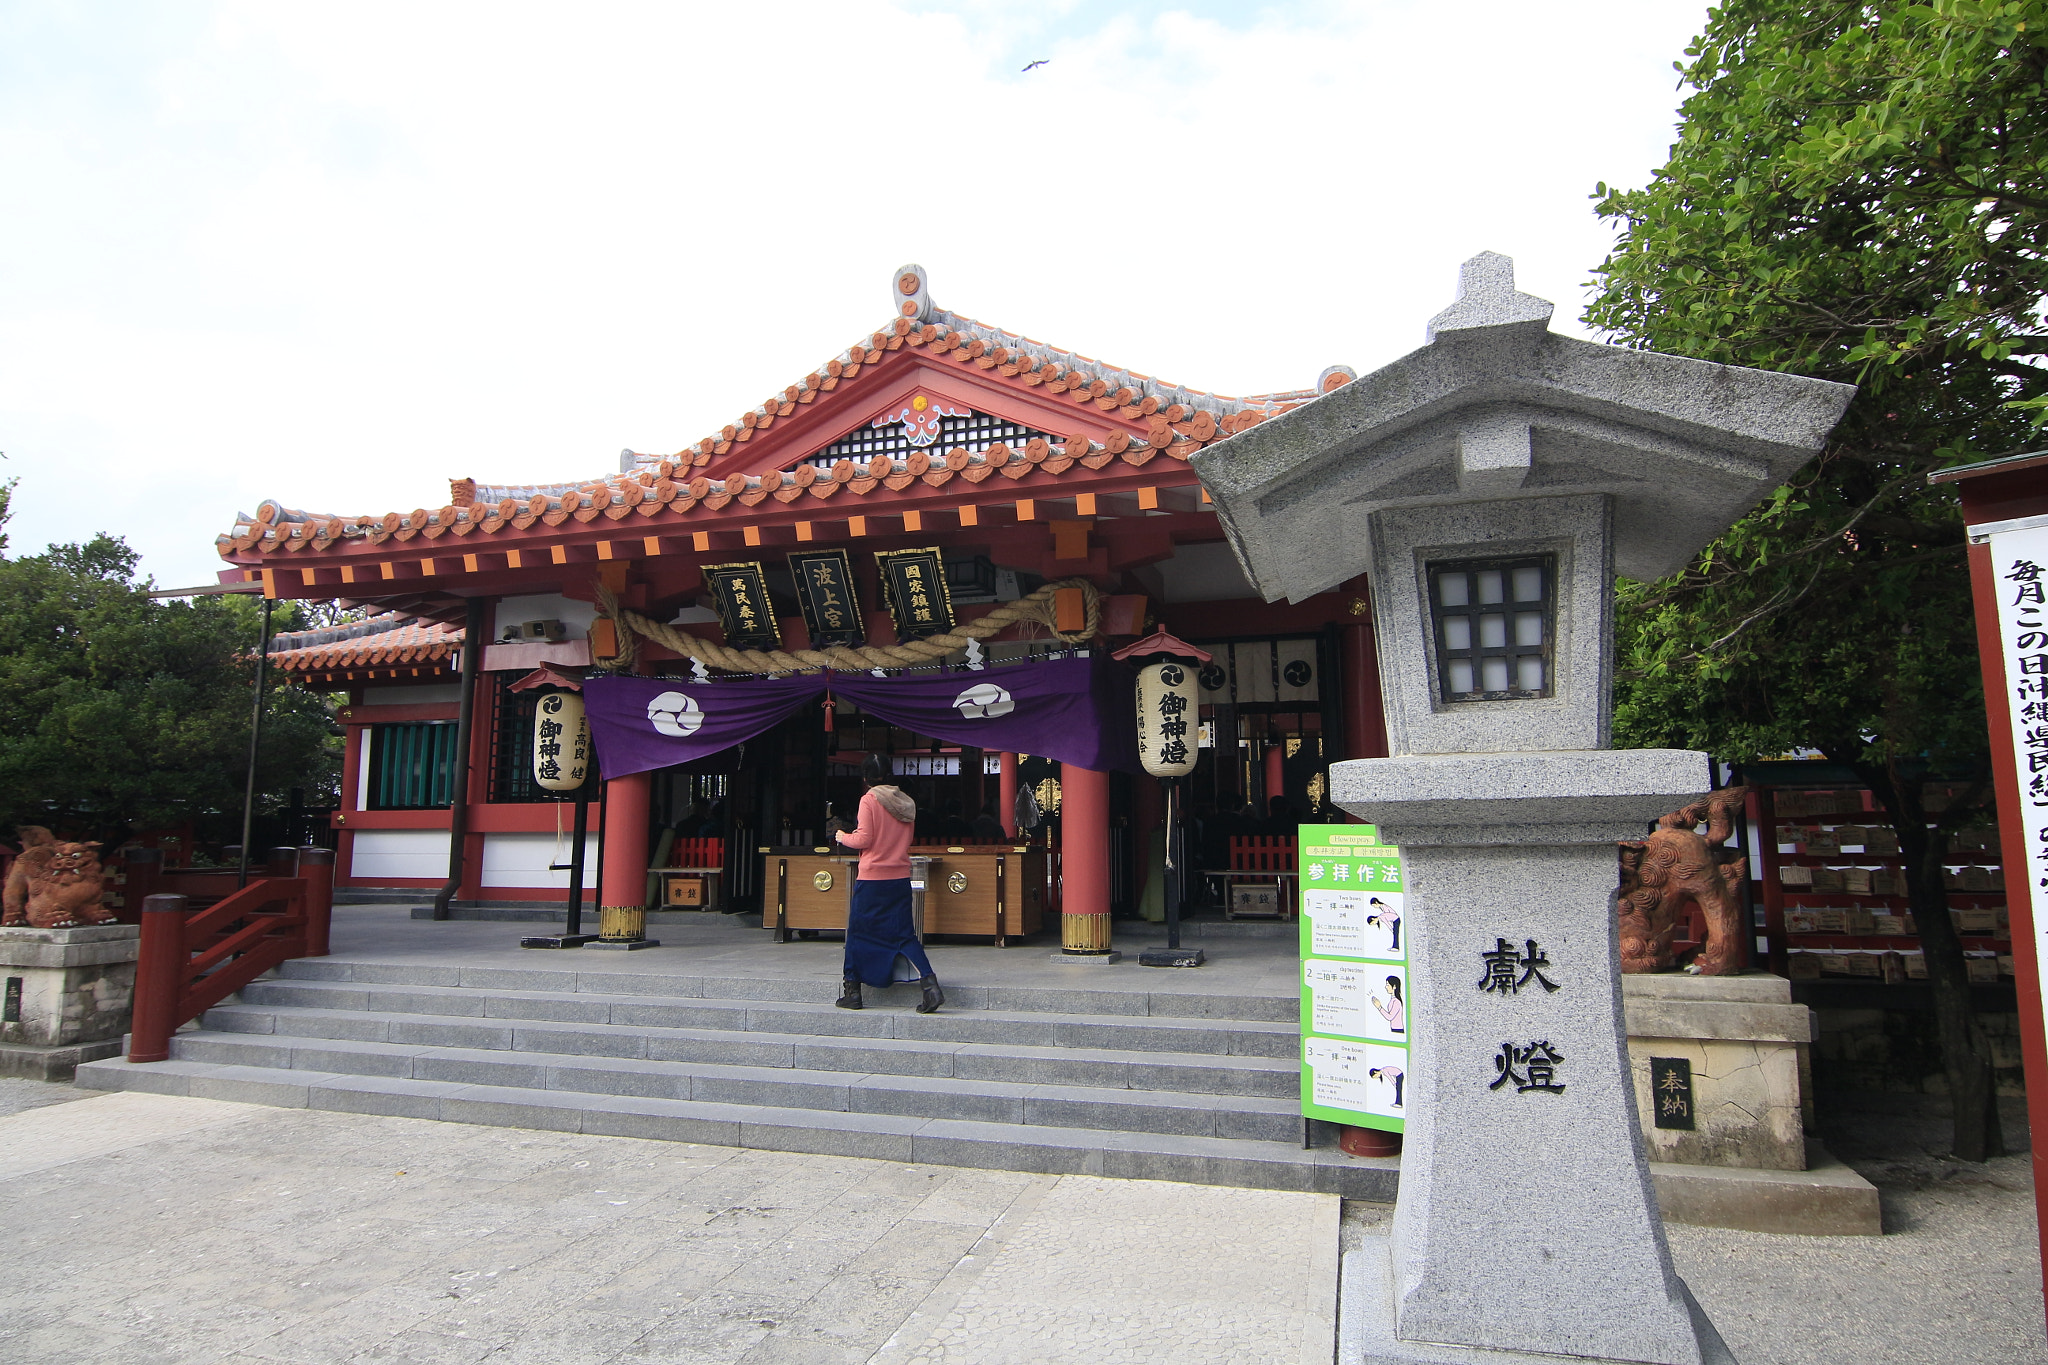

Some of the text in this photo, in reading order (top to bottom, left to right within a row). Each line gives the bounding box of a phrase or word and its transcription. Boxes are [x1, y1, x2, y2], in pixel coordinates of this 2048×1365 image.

[731, 578, 758, 632] 萬民泰平
[813, 562, 844, 629] 波上宮
[539, 718, 563, 780] 御神燈
[1158, 691, 1189, 765] 御神燈
[1308, 862, 1399, 883] 参拝作法
[1306, 968, 1313, 978] 2
[1316, 972, 1338, 981] 二拍手
[1307, 1046, 1313, 1056] 3
[1660, 1069, 1688, 1117] 奉納
